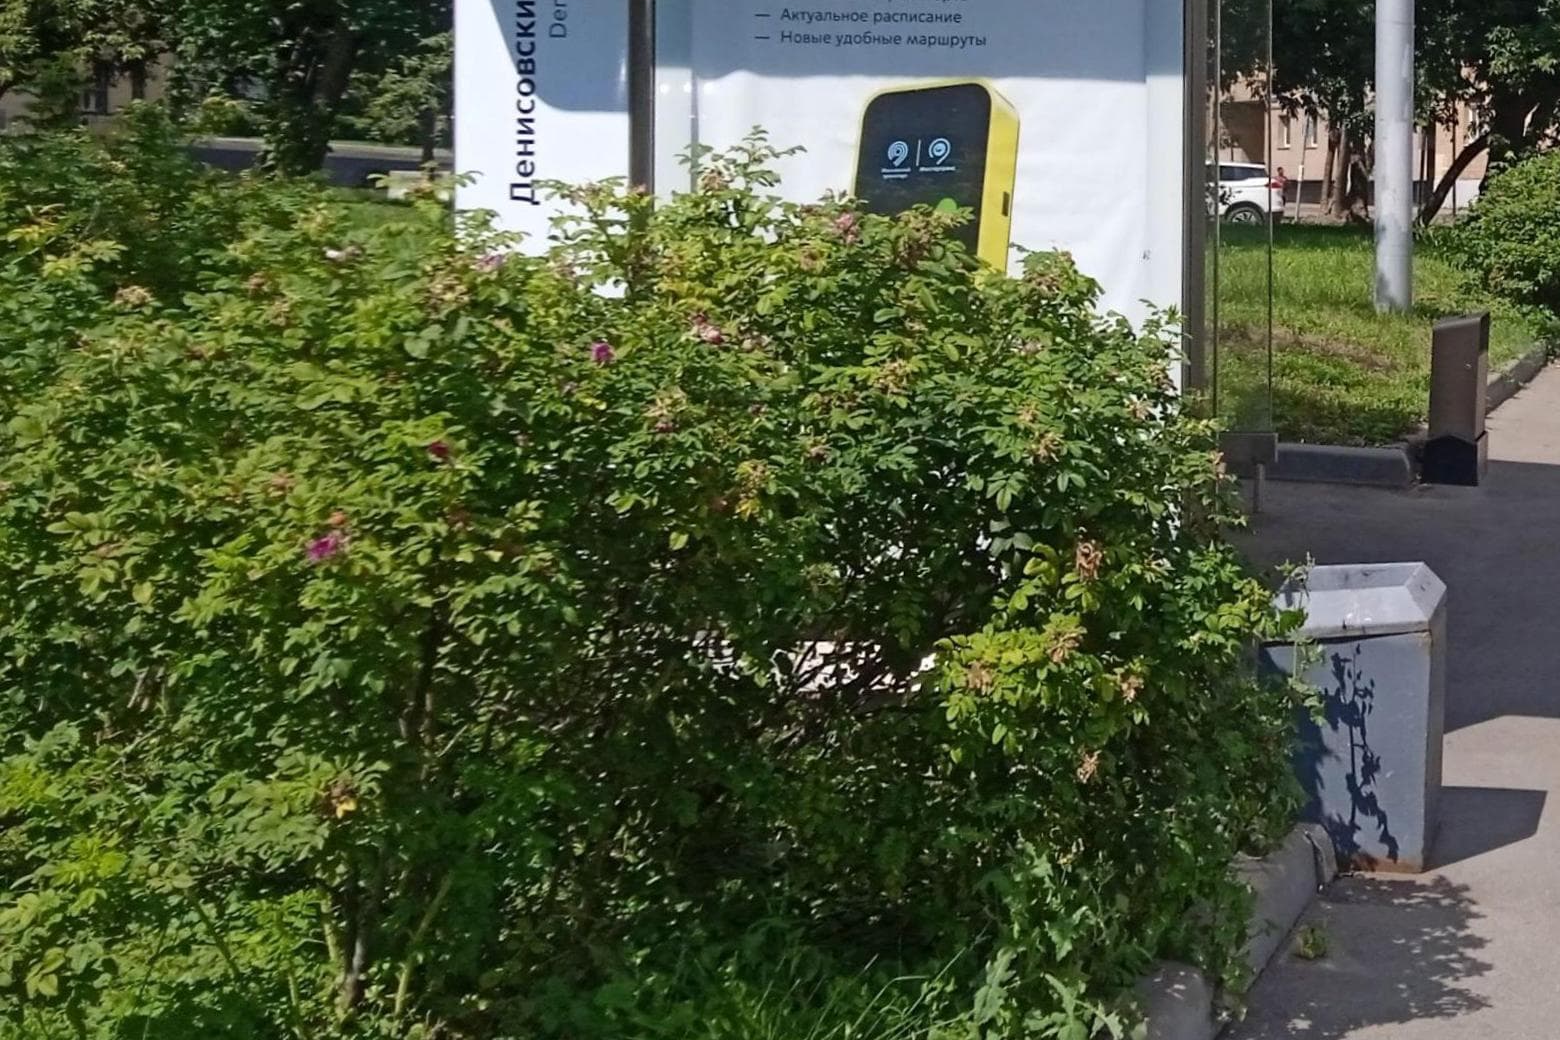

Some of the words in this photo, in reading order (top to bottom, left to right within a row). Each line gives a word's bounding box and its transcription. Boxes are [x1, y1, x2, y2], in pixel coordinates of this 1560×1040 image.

[780, 7, 869, 24] Актуальное
[873, 11, 963, 25] расписание
[780, 30, 832, 45] Новые
[836, 30, 902, 47] удобные
[907, 34, 987, 50] маршруты
